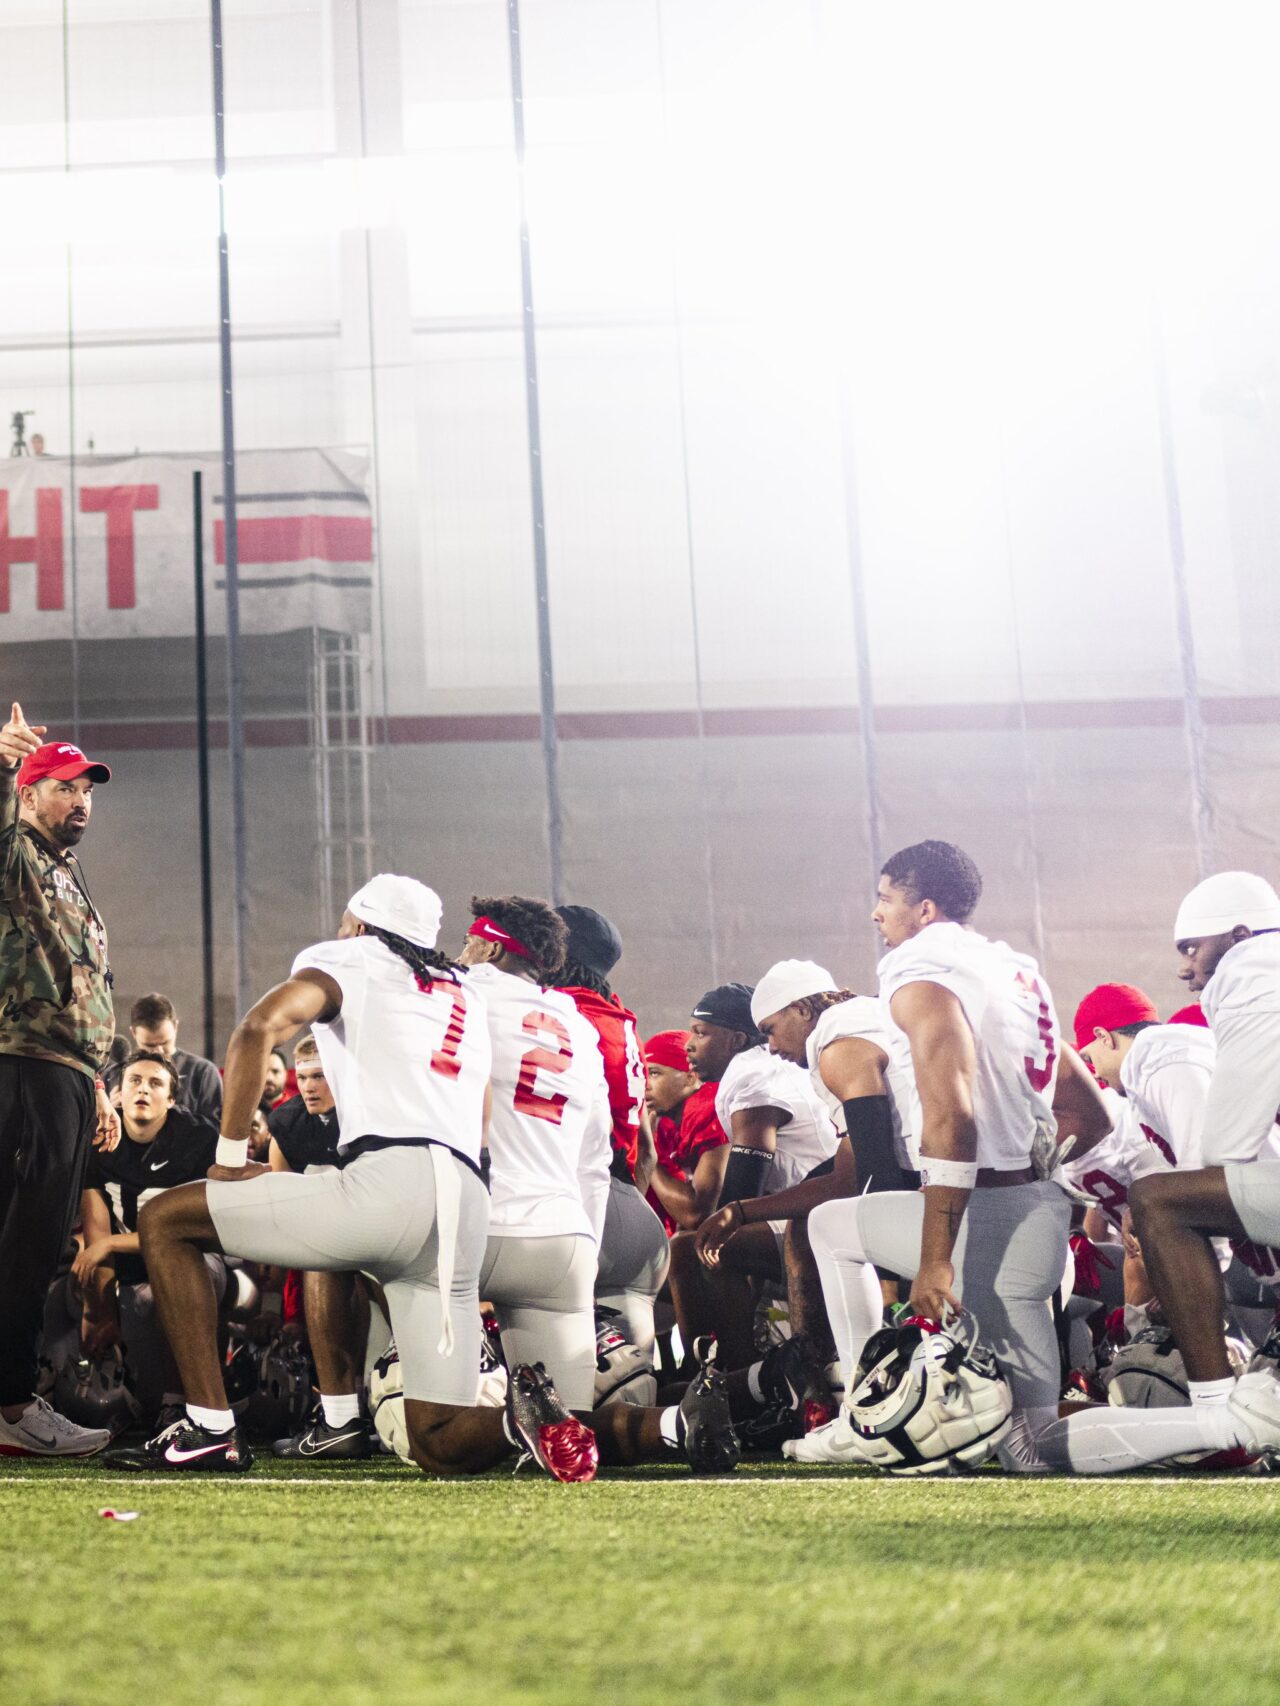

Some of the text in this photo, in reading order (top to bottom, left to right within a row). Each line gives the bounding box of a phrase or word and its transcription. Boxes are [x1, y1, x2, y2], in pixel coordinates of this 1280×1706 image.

[513, 1010, 574, 1126] 2
[731, 1146, 773, 1160] NIKE PRO
